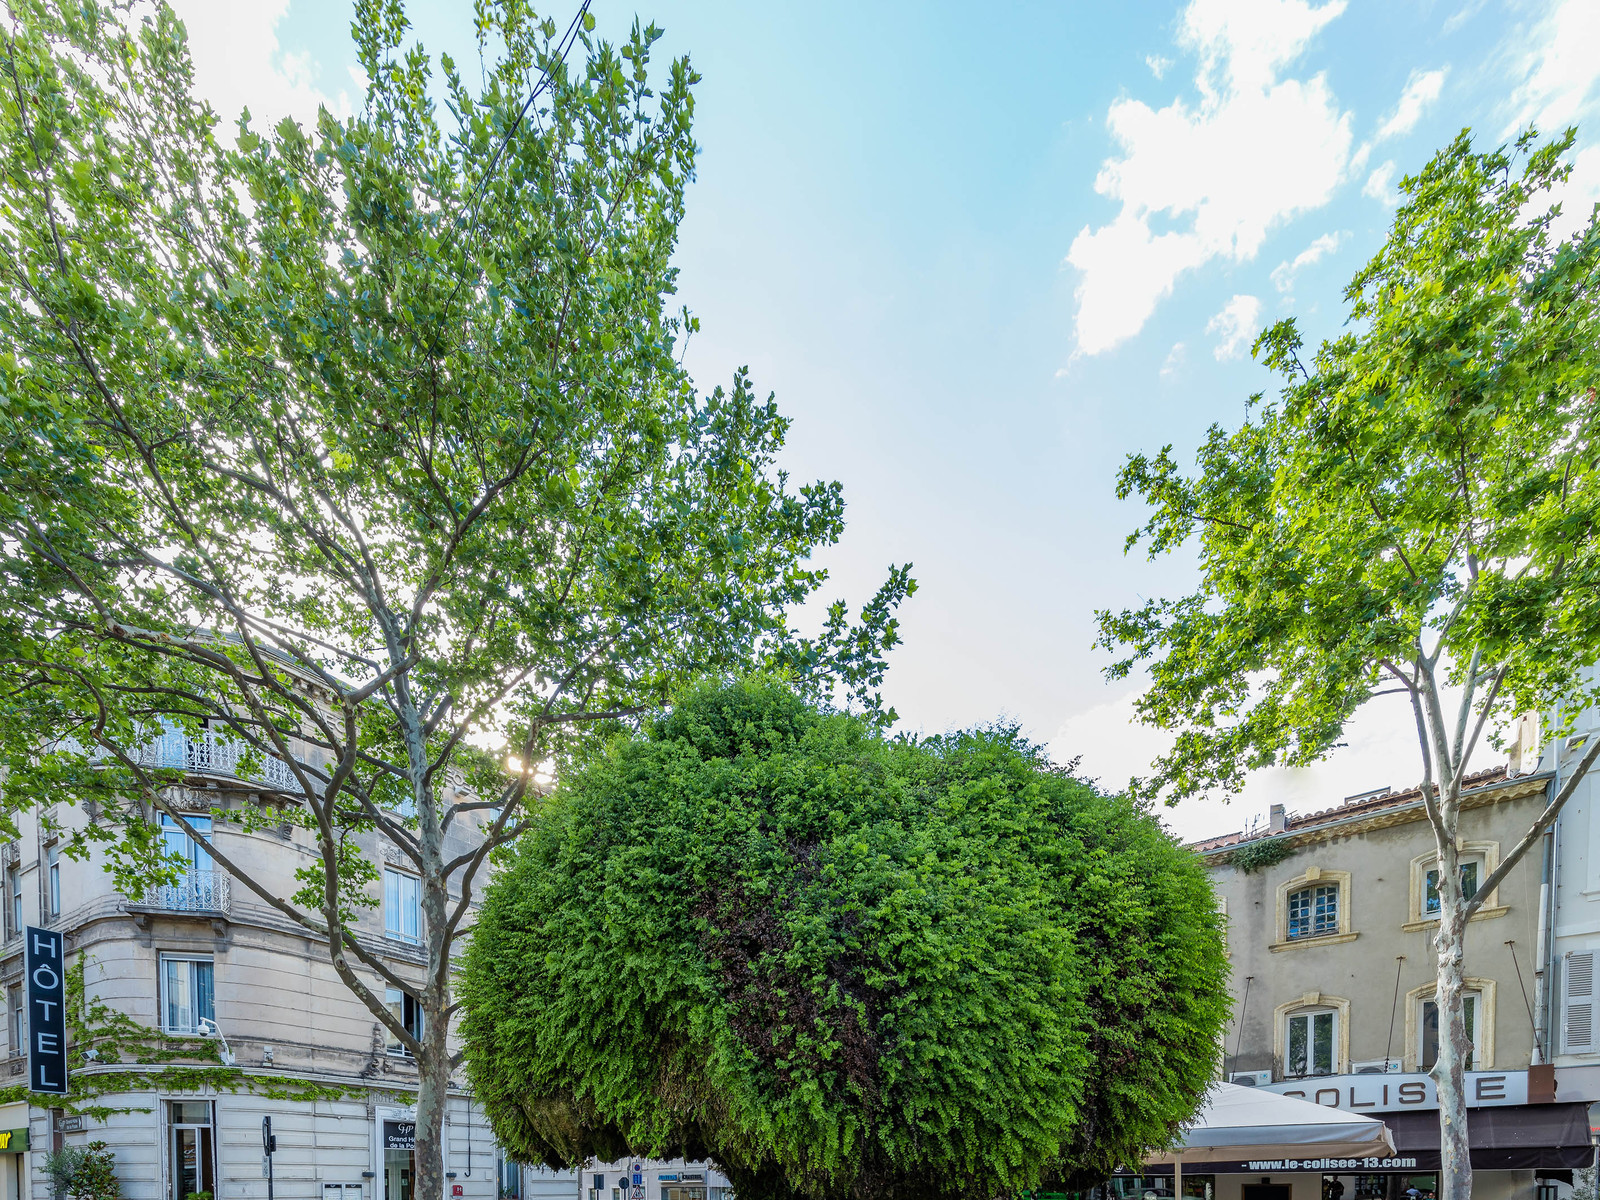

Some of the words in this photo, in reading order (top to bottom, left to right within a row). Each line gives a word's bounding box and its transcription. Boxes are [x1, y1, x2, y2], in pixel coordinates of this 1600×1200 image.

[33, 933, 59, 1087] HÔTEL
[1283, 1076, 1506, 1109] OLISE
[388, 1135, 408, 1143] Grand
[1249, 1157, 1417, 1170] www.le-colisee-13.com
